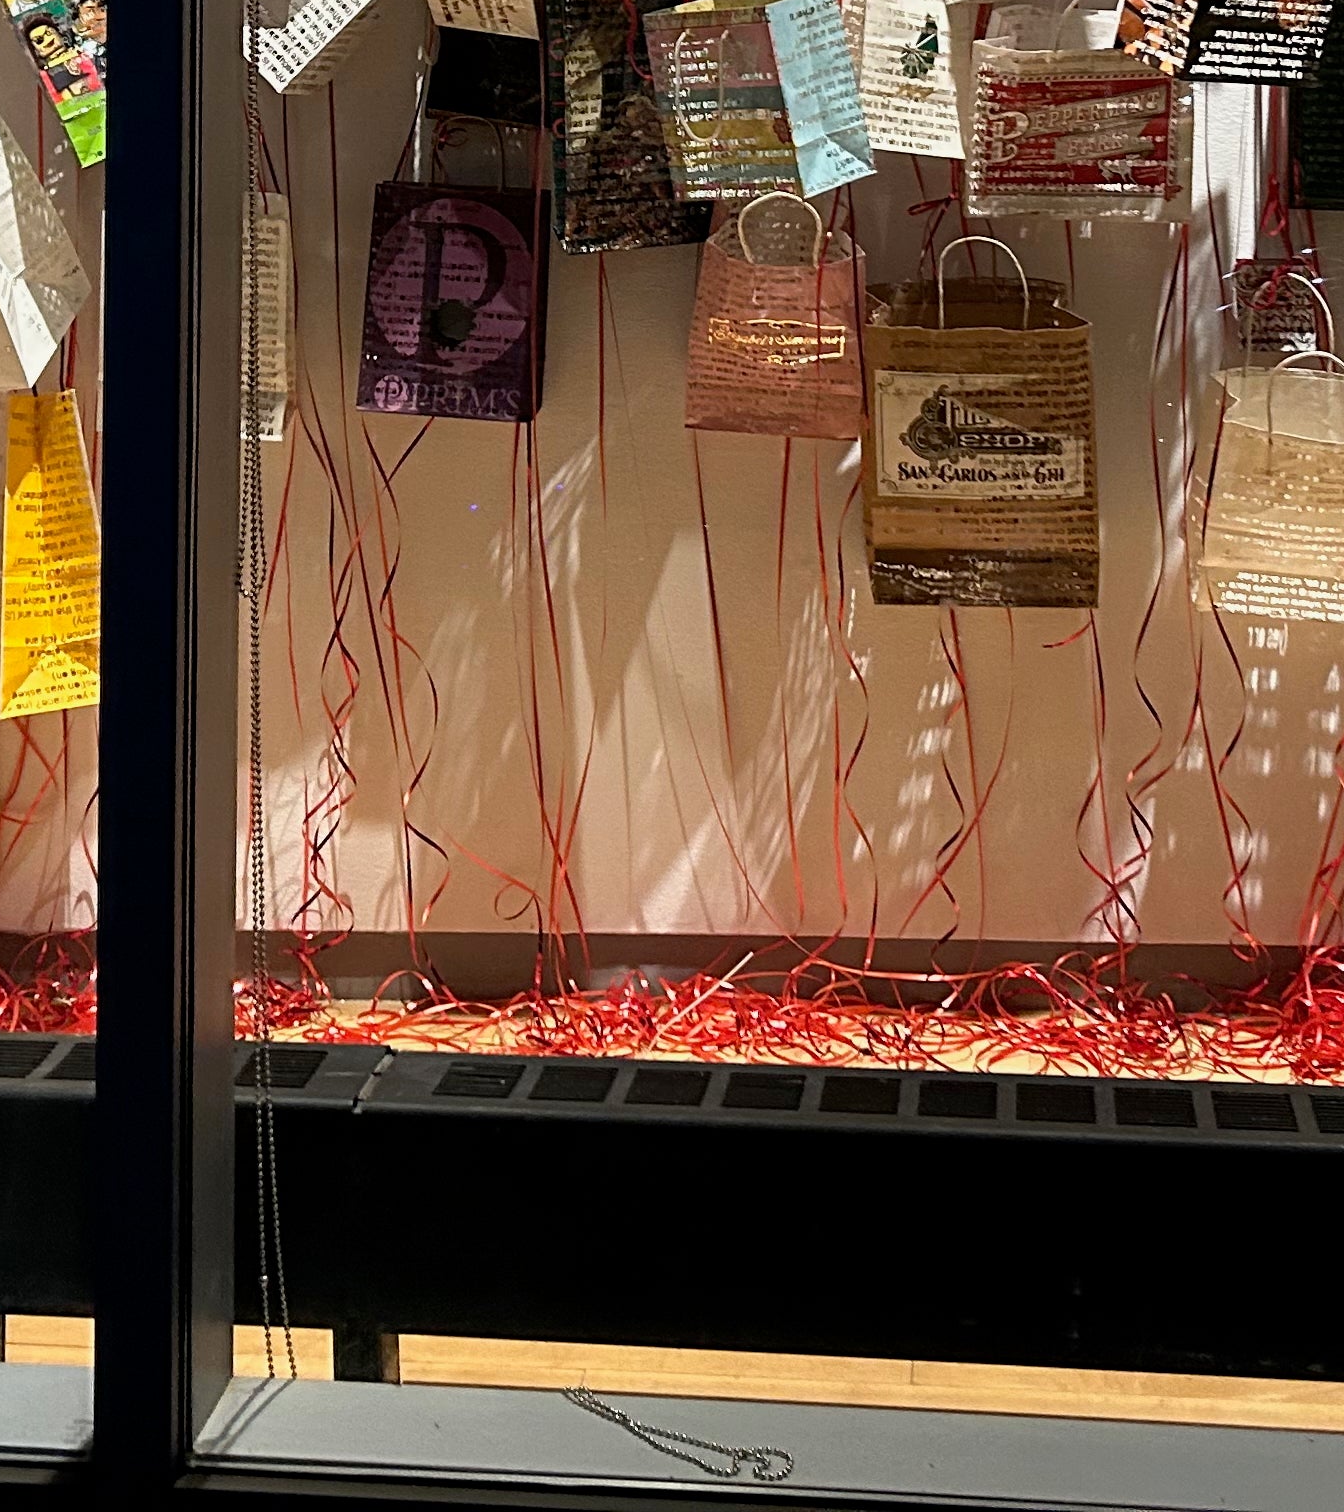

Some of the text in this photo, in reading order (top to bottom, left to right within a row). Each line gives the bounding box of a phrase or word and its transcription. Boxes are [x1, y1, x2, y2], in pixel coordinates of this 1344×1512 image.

[958, 432, 1048, 448] SHOP
[897, 461, 927, 481] SAN
[937, 463, 997, 483] CARLOS
